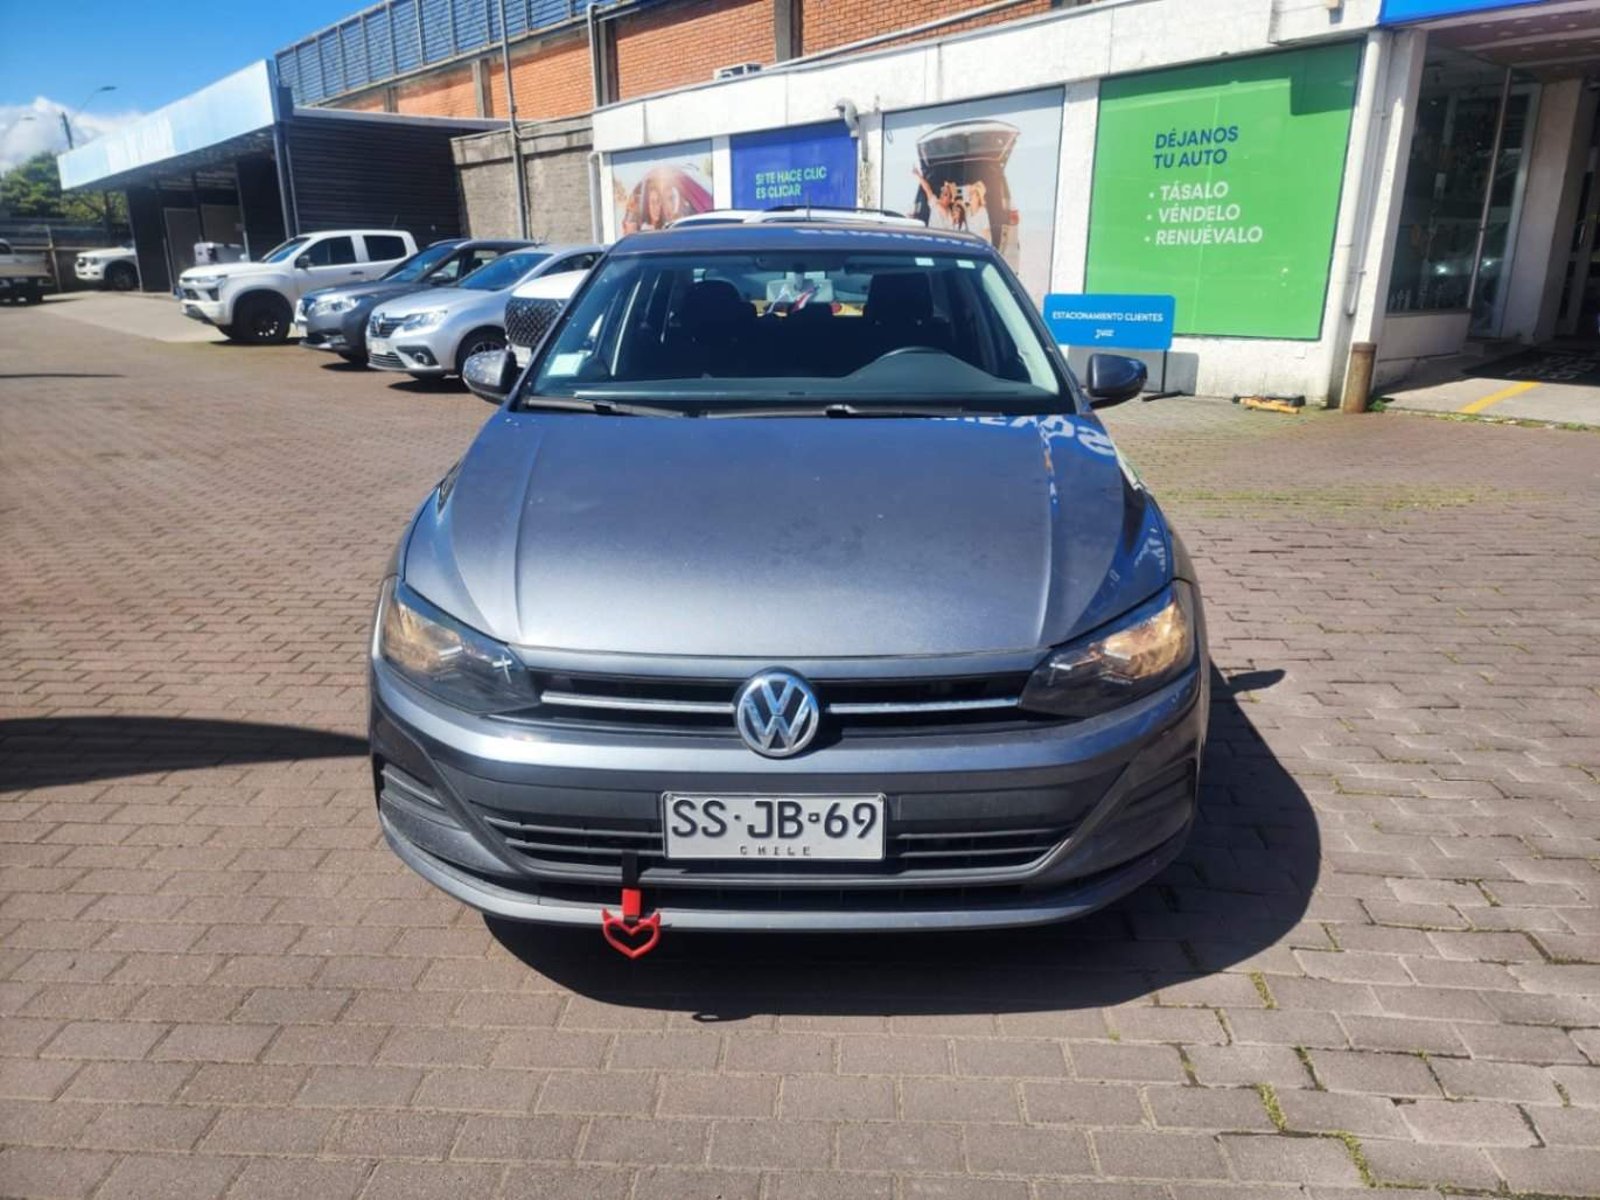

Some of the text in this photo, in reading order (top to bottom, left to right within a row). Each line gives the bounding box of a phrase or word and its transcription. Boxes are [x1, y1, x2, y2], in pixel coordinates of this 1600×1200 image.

[1154, 126, 1239, 149] DÉJANOS
[1153, 148, 1228, 169] TU AUTO
[777, 169, 802, 183] HACE
[803, 165, 828, 180] CLIC
[755, 183, 802, 199] ES CLICAR
[1159, 180, 1229, 201] TÁSALO
[1158, 202, 1241, 223] VÉNDELO
[1155, 224, 1263, 246] RENUÉVALO
[1052, 310, 1164, 323] ESTACIONAMIENTO CLIENTES
[739, 845, 812, 857] CHILE
